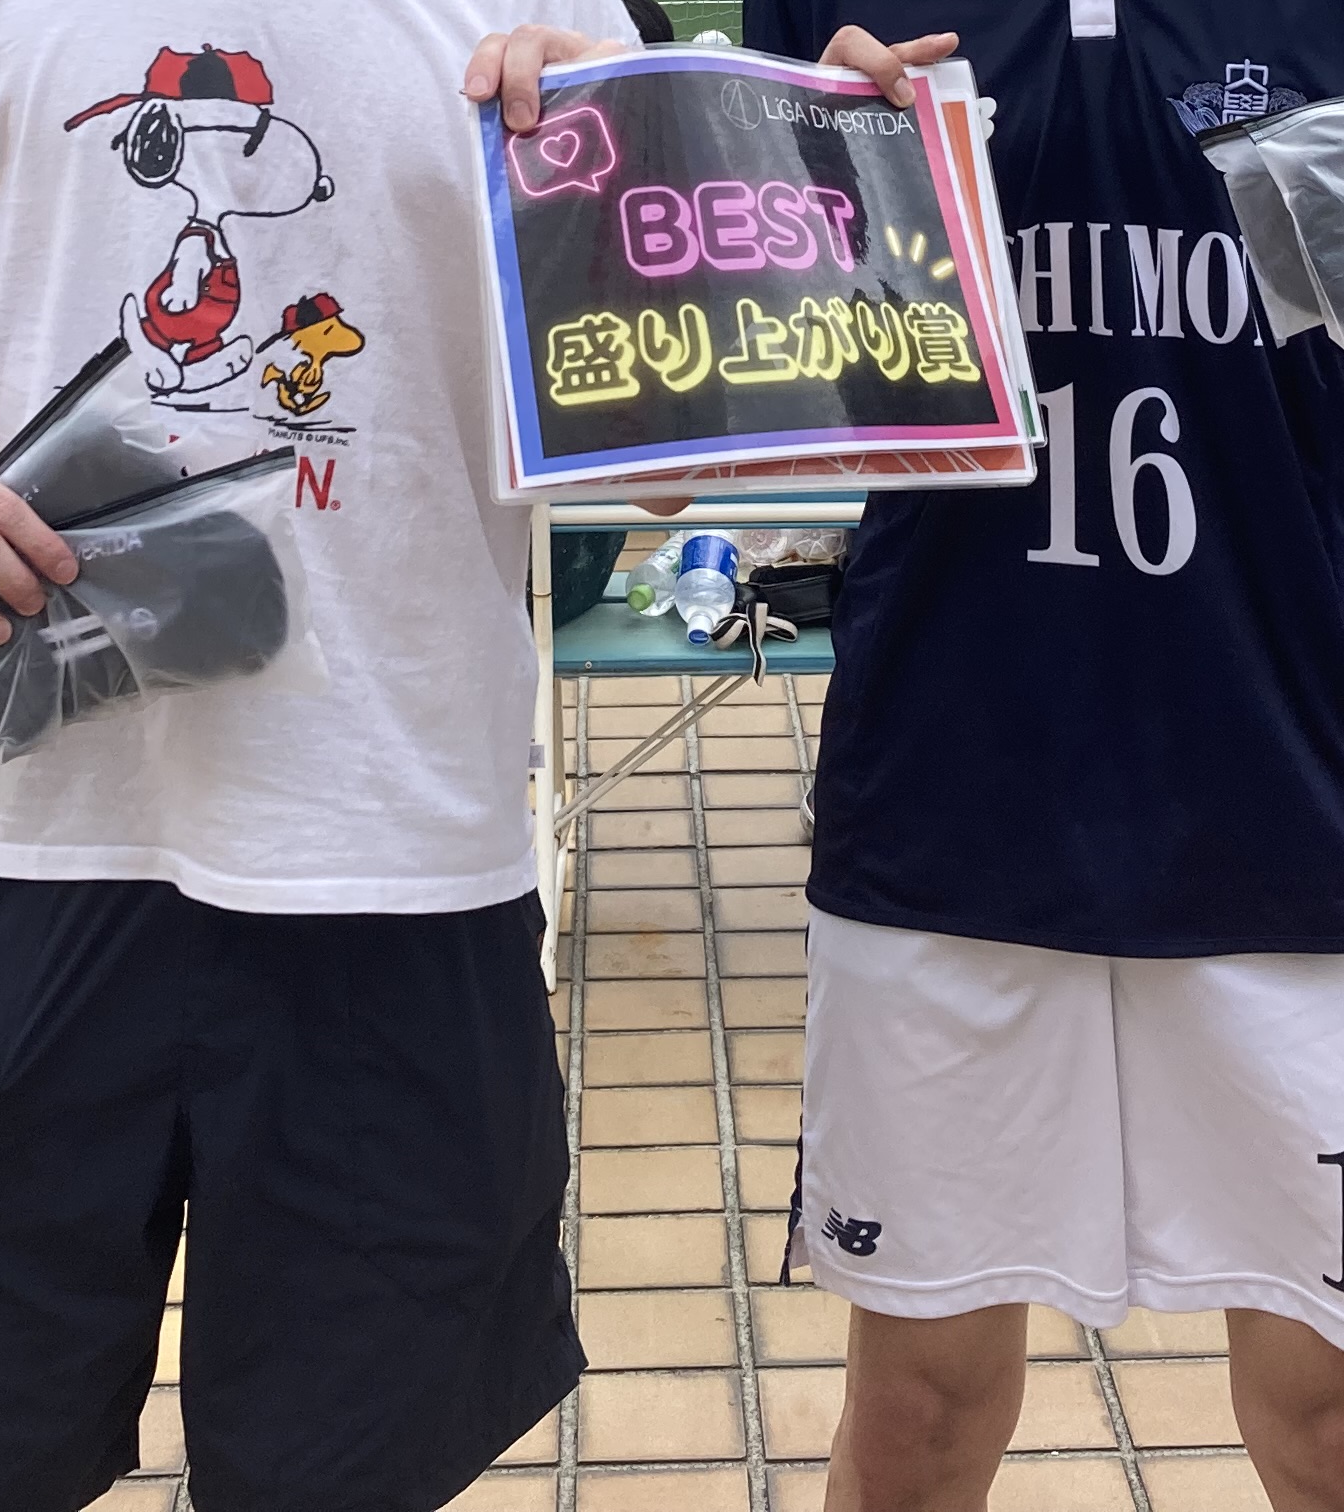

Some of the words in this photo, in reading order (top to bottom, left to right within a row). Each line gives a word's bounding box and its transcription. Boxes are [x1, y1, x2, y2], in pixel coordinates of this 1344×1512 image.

[619, 180, 856, 278] BEST
[545, 295, 981, 406] 盛り上がり賞
[1027, 381, 1197, 576] 16
